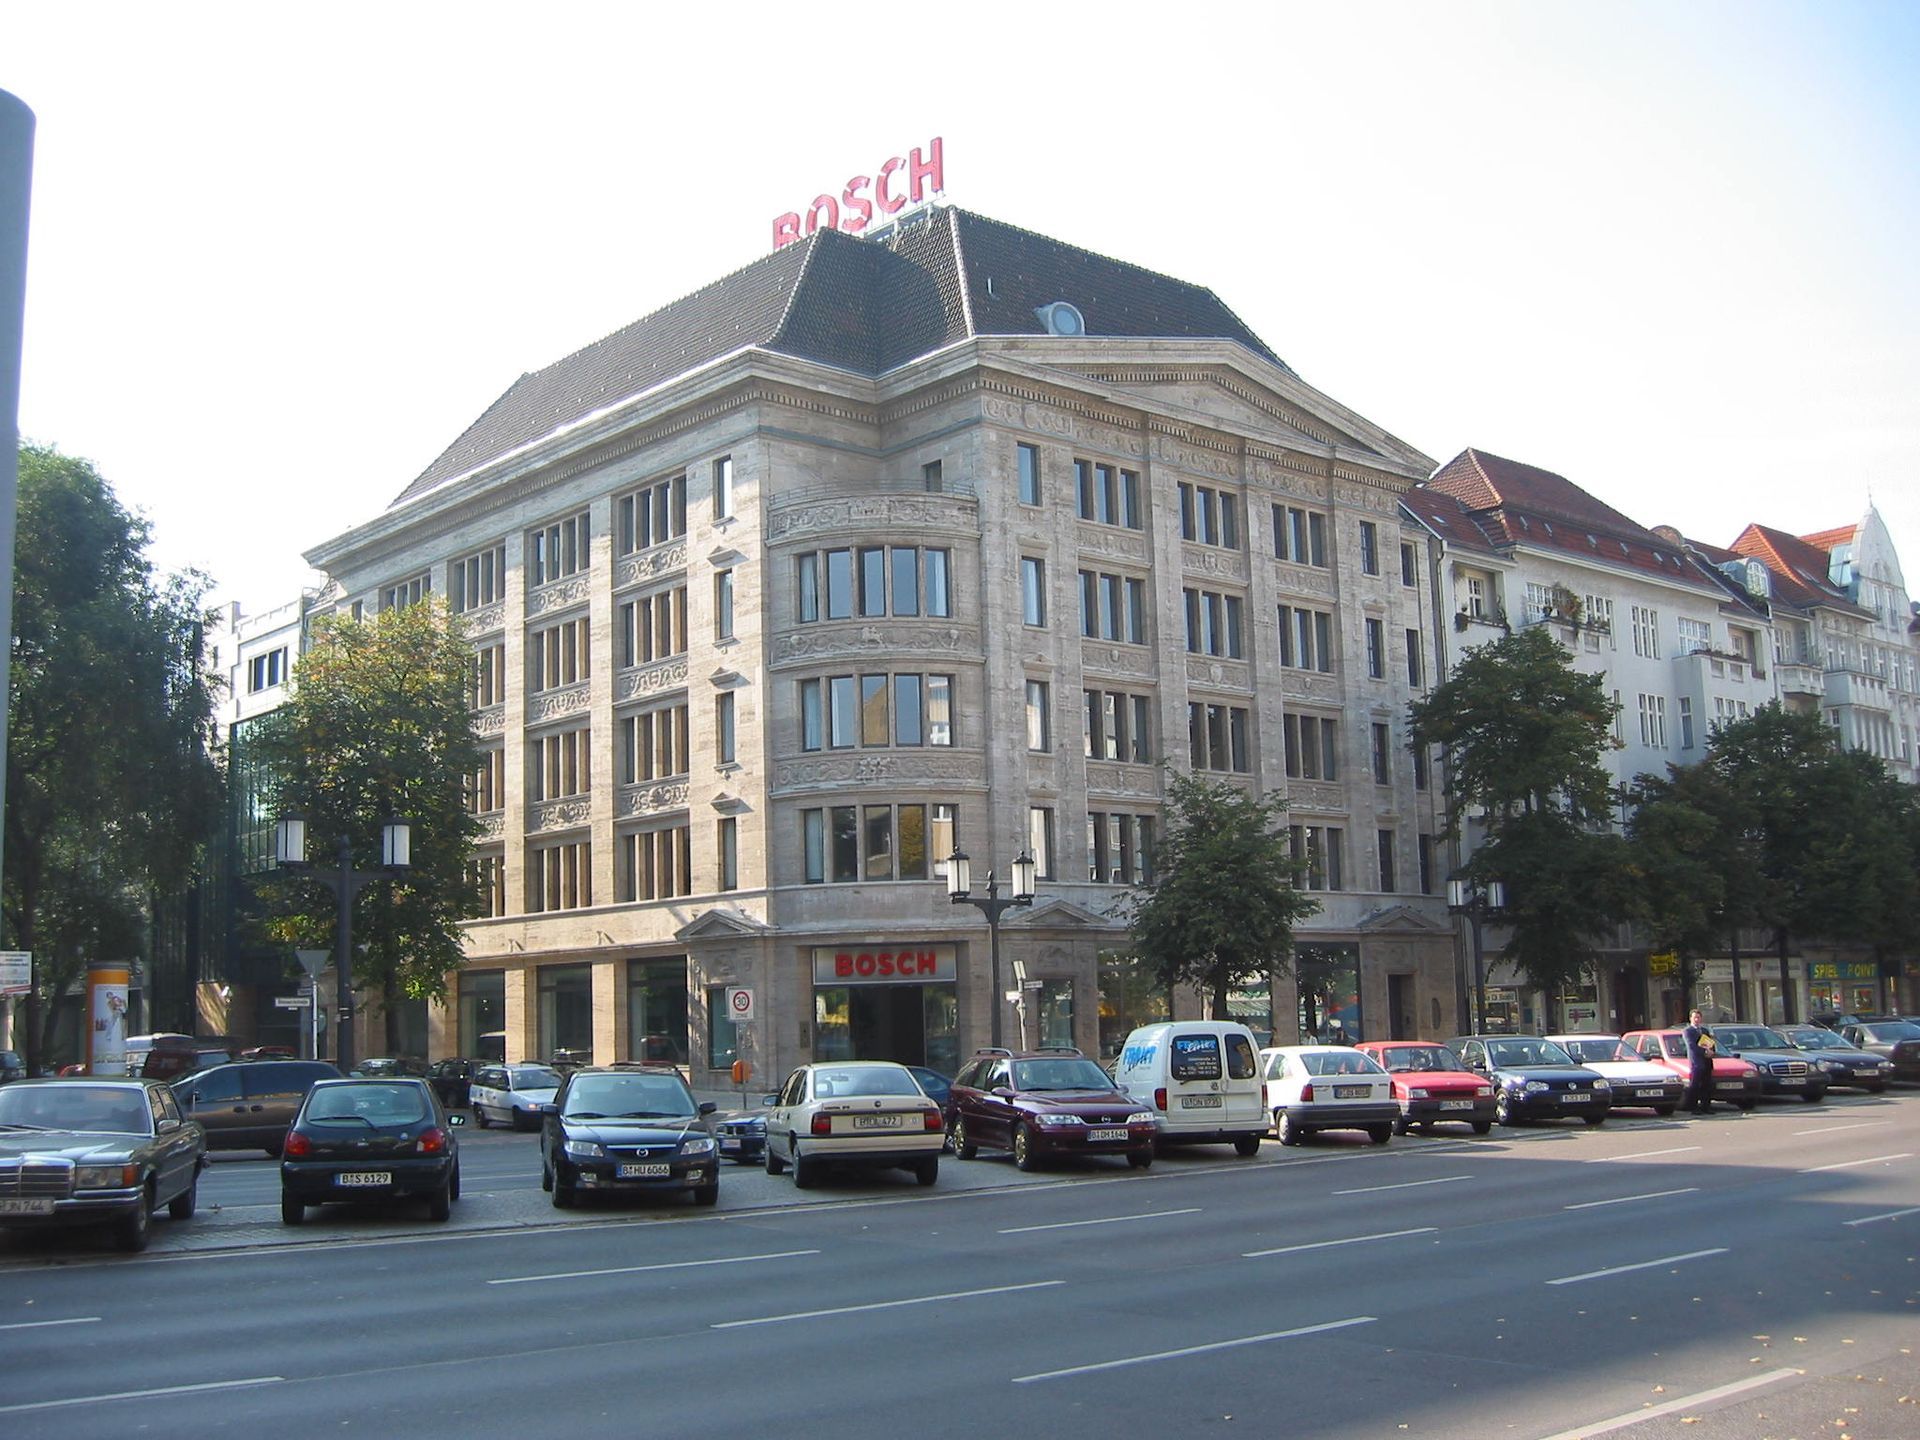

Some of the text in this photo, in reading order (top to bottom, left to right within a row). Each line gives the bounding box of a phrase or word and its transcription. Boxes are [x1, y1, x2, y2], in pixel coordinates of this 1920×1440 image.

[773, 136, 944, 251] BOSCH
[835, 951, 936, 977] BOSCH
[1814, 963, 1876, 979] SPIEL POINT
[736, 995, 747, 1007] 30
[363, 1173, 389, 1184] 6129
